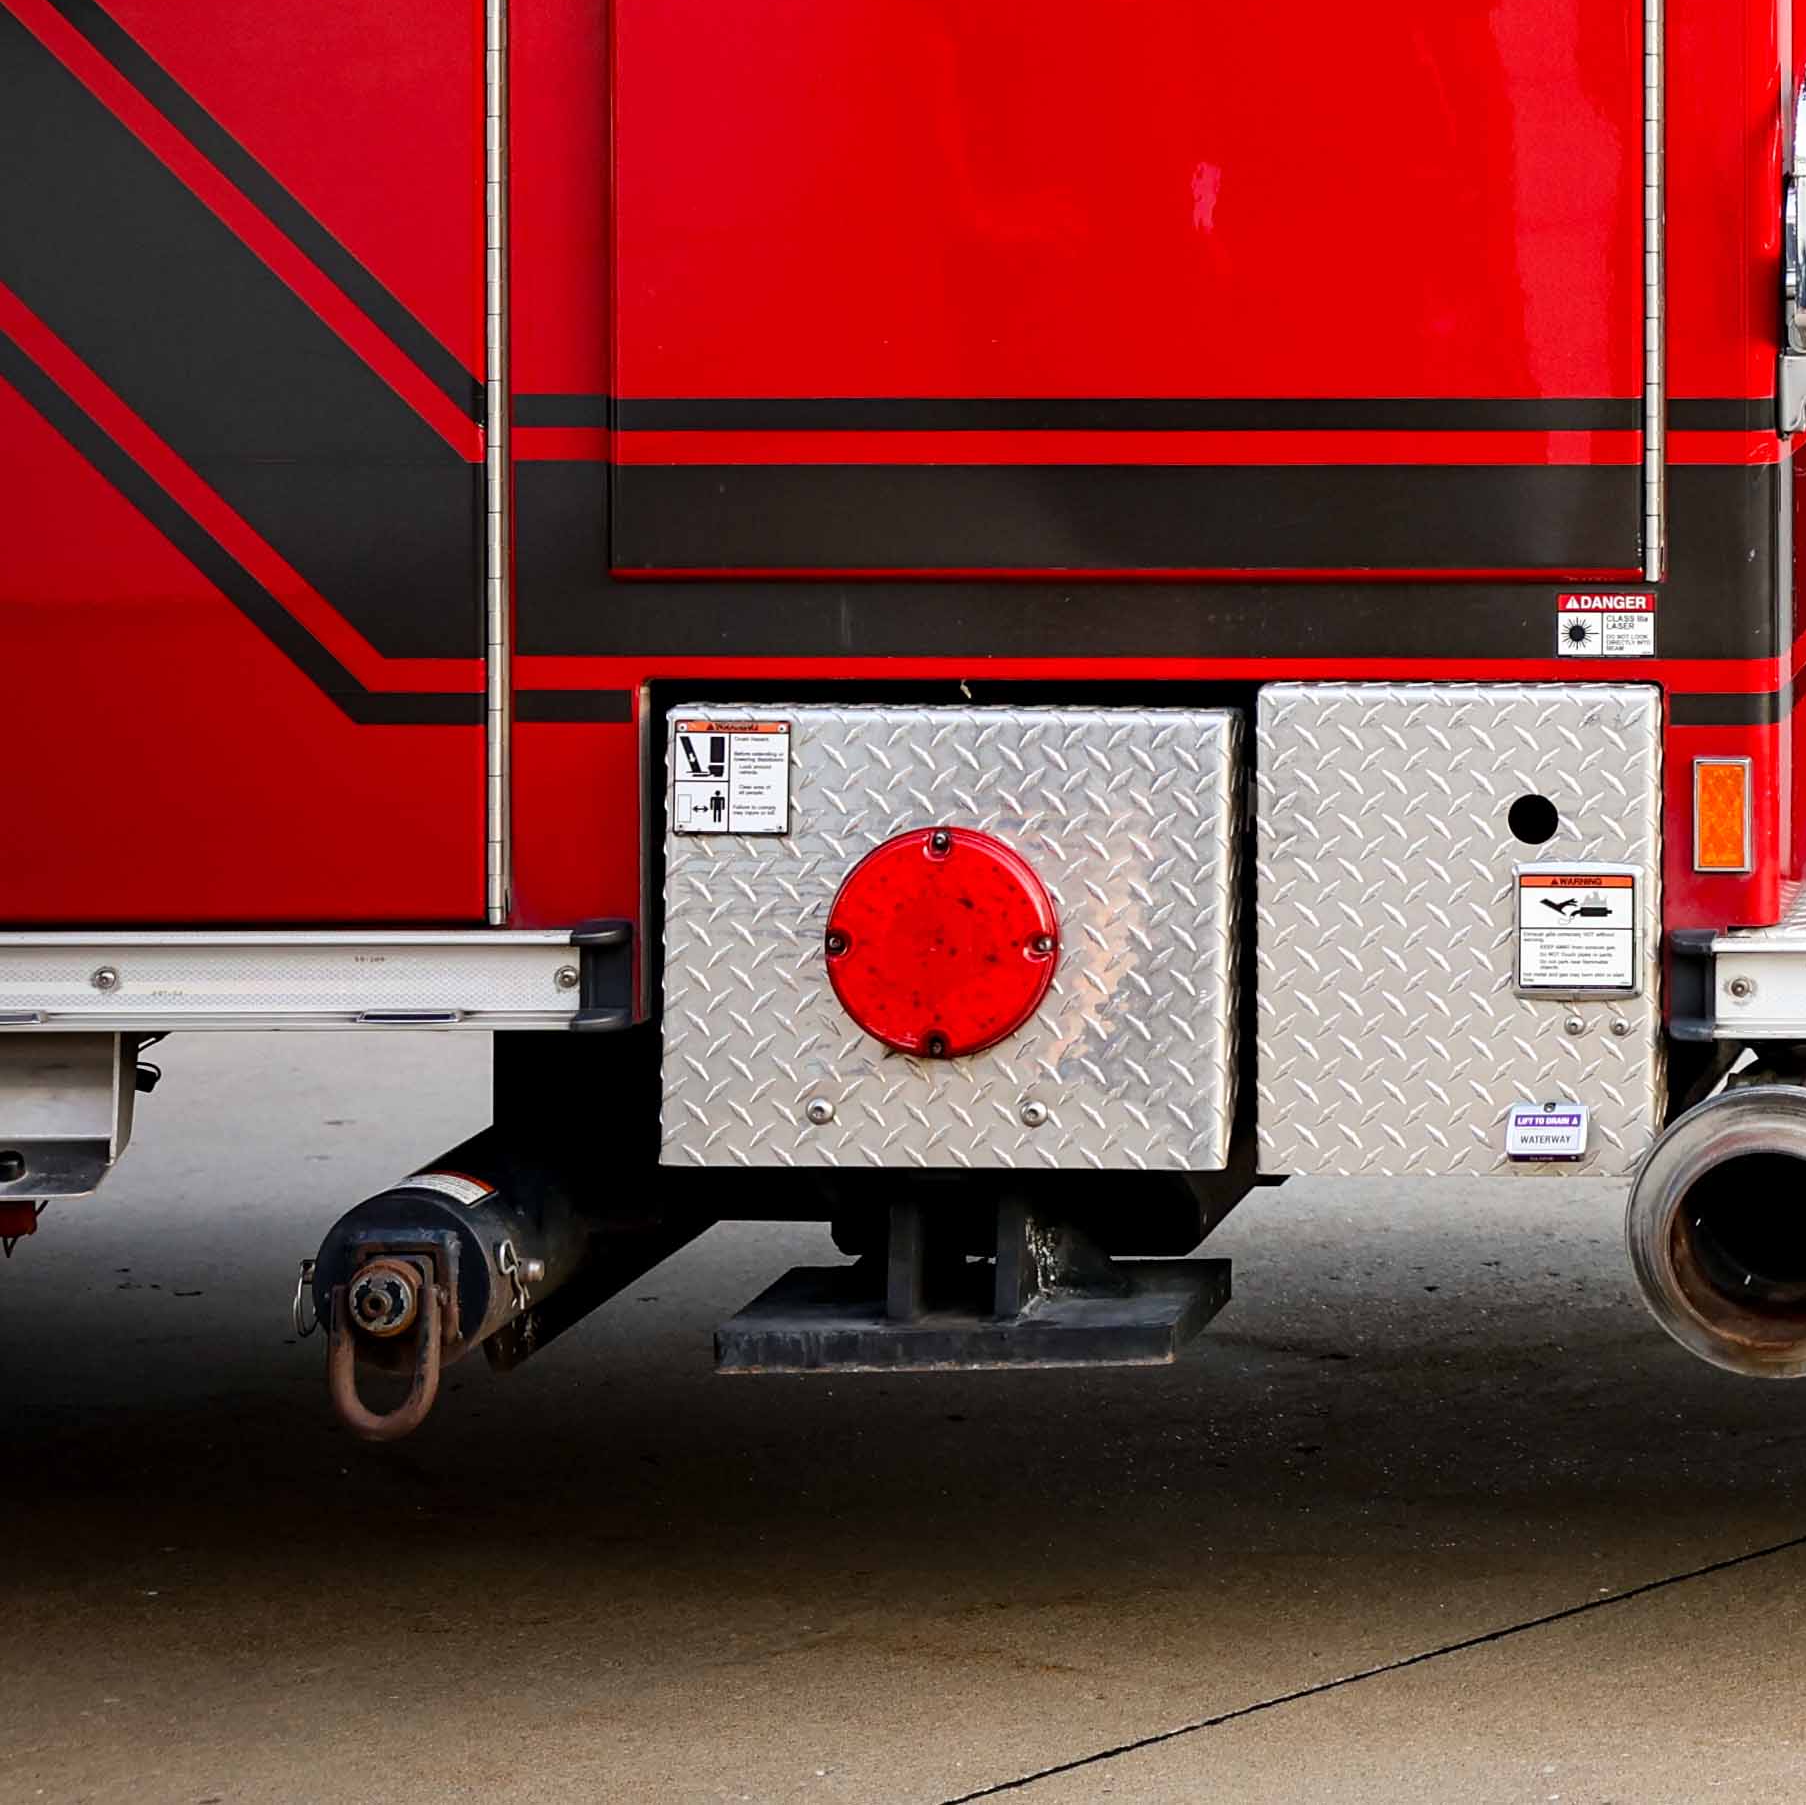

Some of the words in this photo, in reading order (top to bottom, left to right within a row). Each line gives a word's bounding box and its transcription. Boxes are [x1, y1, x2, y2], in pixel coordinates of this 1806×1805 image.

[1580, 596, 1647, 610] DANGER
[1517, 1117, 1533, 1125] LIFT
[1535, 1117, 1544, 1125] TO
[1545, 1117, 1570, 1125] DRAIN
[1520, 1135, 1571, 1144] WATERWAY
